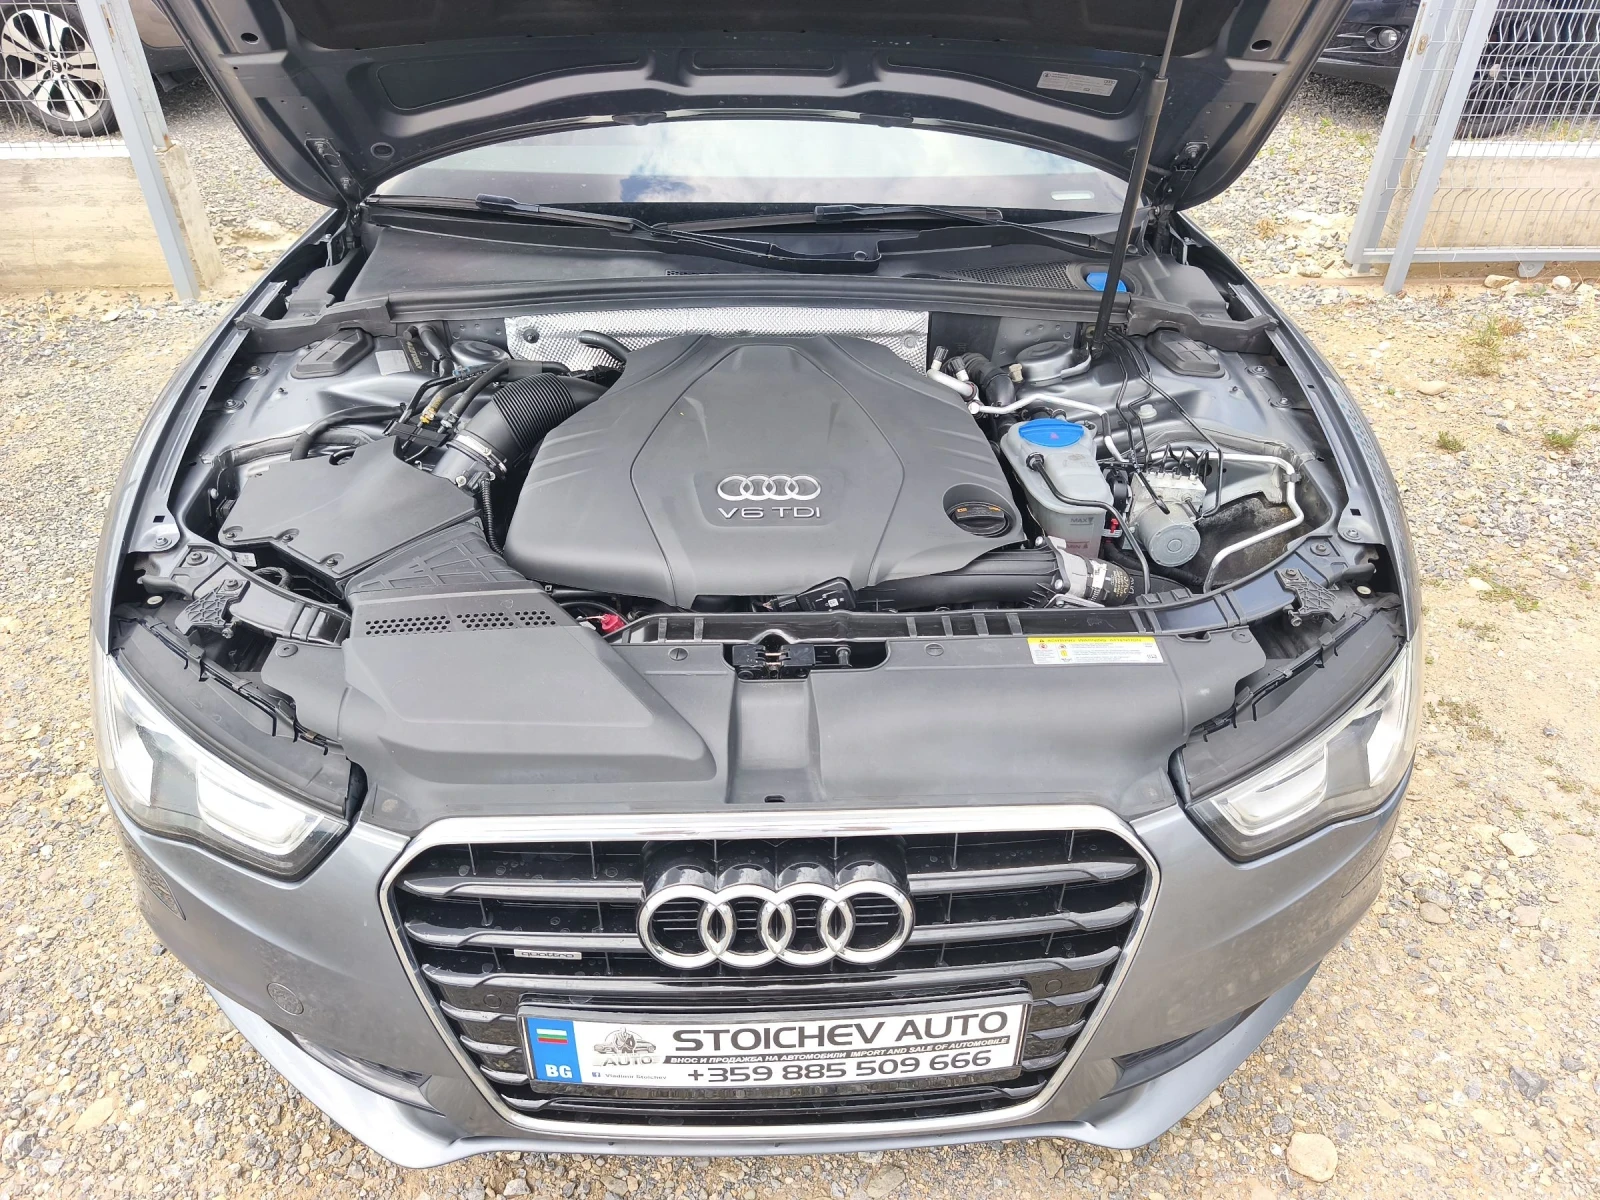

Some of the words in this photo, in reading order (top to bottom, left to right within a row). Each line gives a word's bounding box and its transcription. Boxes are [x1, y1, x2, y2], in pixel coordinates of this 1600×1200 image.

[717, 506, 764, 519] V6
[771, 506, 821, 518] TDI
[521, 951, 574, 959] quattro
[672, 1022, 886, 1052] STOICHEV
[895, 1011, 1008, 1042] AUTO
[850, 1049, 886, 1058] IMPORT
[886, 1047, 907, 1055] AND
[909, 1044, 933, 1053] SALE
[935, 1043, 949, 1051] OF
[950, 1037, 1009, 1050] AUTOMOBILE
[602, 1055, 653, 1067] AUTO
[709, 1055, 763, 1064] ПРОДАЖБА
[780, 1051, 847, 1061] АВТОМОБИЛИ
[545, 1064, 573, 1079] BG
[687, 1065, 773, 1083] +359
[782, 1062, 847, 1080] 885
[855, 1056, 921, 1077] 509
[929, 1049, 992, 1071] 666
